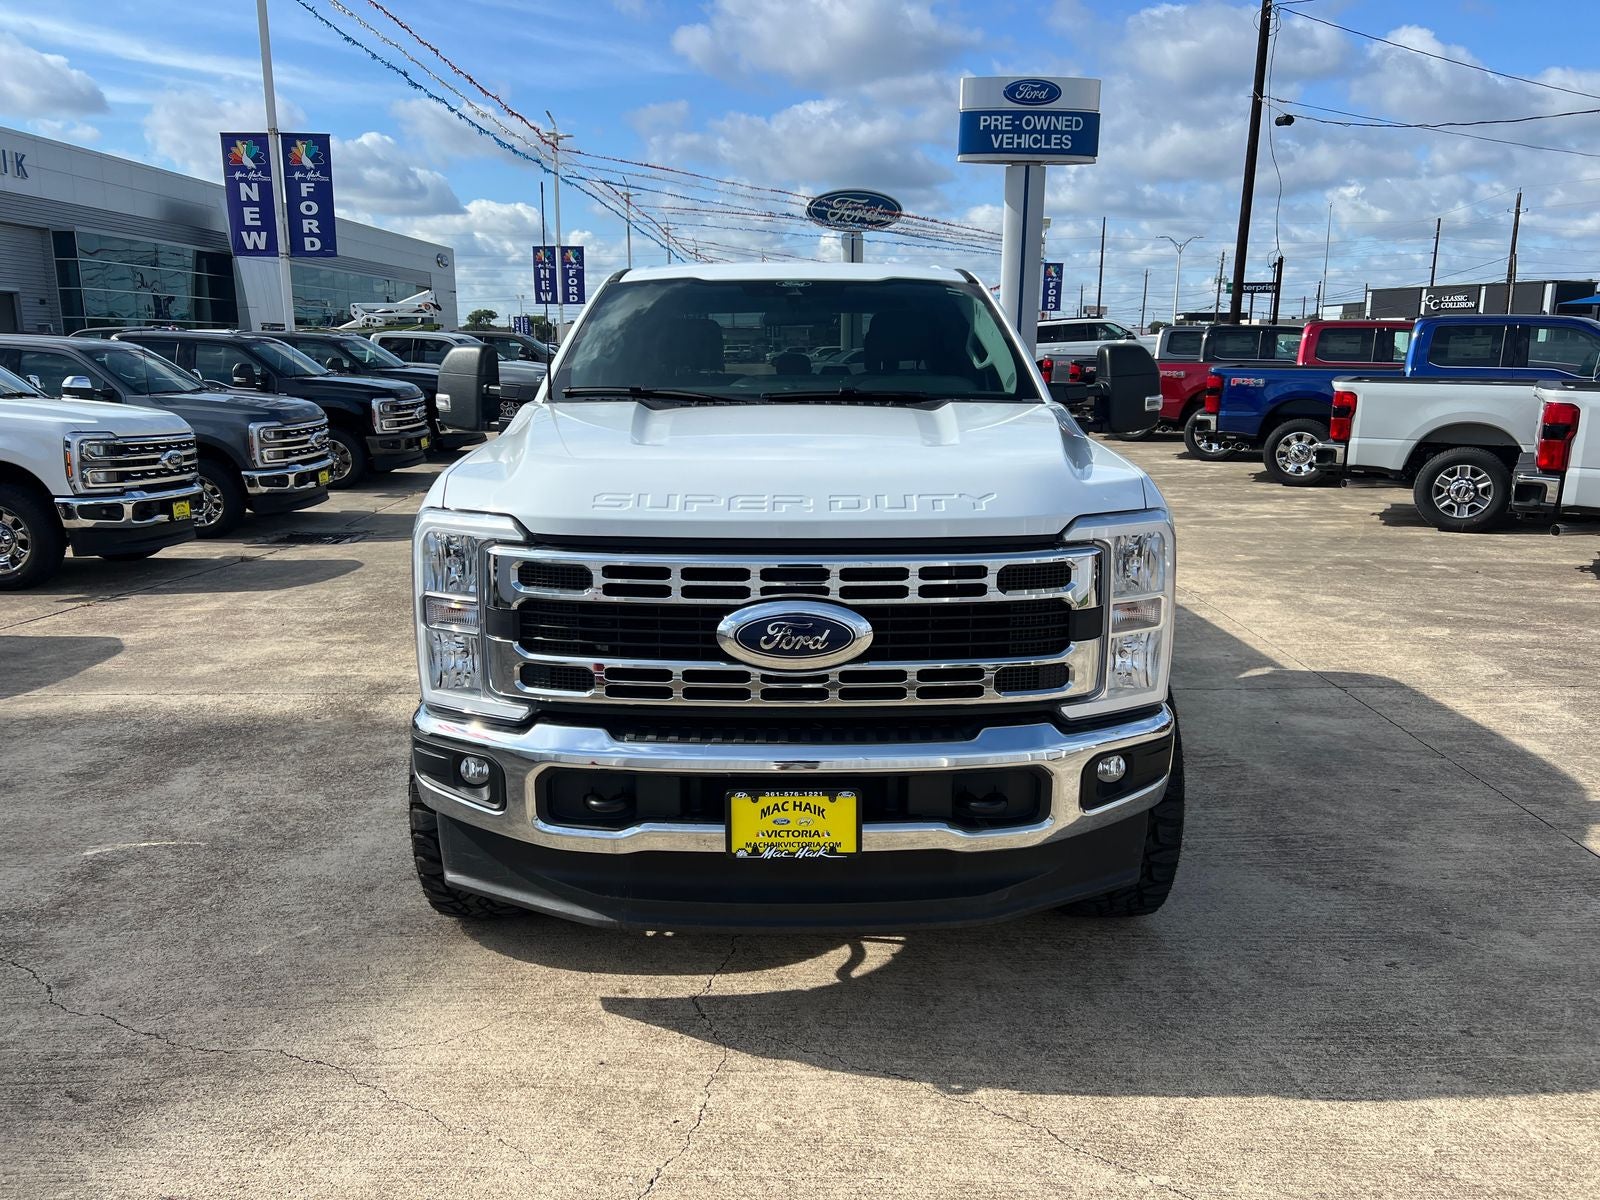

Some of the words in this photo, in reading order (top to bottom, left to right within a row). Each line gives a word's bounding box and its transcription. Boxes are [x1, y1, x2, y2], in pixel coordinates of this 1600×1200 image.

[1015, 83, 1050, 99] Ford
[991, 134, 1072, 149] VEHICLES
[239, 182, 267, 250] NEW
[300, 182, 321, 252] FORD
[827, 197, 886, 221] Ford
[540, 269, 552, 301] NEW
[568, 269, 578, 302] FORD
[1047, 281, 1056, 310] FORD
[1230, 378, 1265, 387] FX4
[592, 492, 814, 514] SUPER
[829, 492, 998, 514] DUTY
[760, 621, 830, 651] Ford
[760, 800, 789, 820] MAC
[793, 800, 827, 820] HAIK
[766, 829, 821, 838] VICTORIA
[760, 846, 790, 859] Mac
[794, 845, 830, 859] Haik
